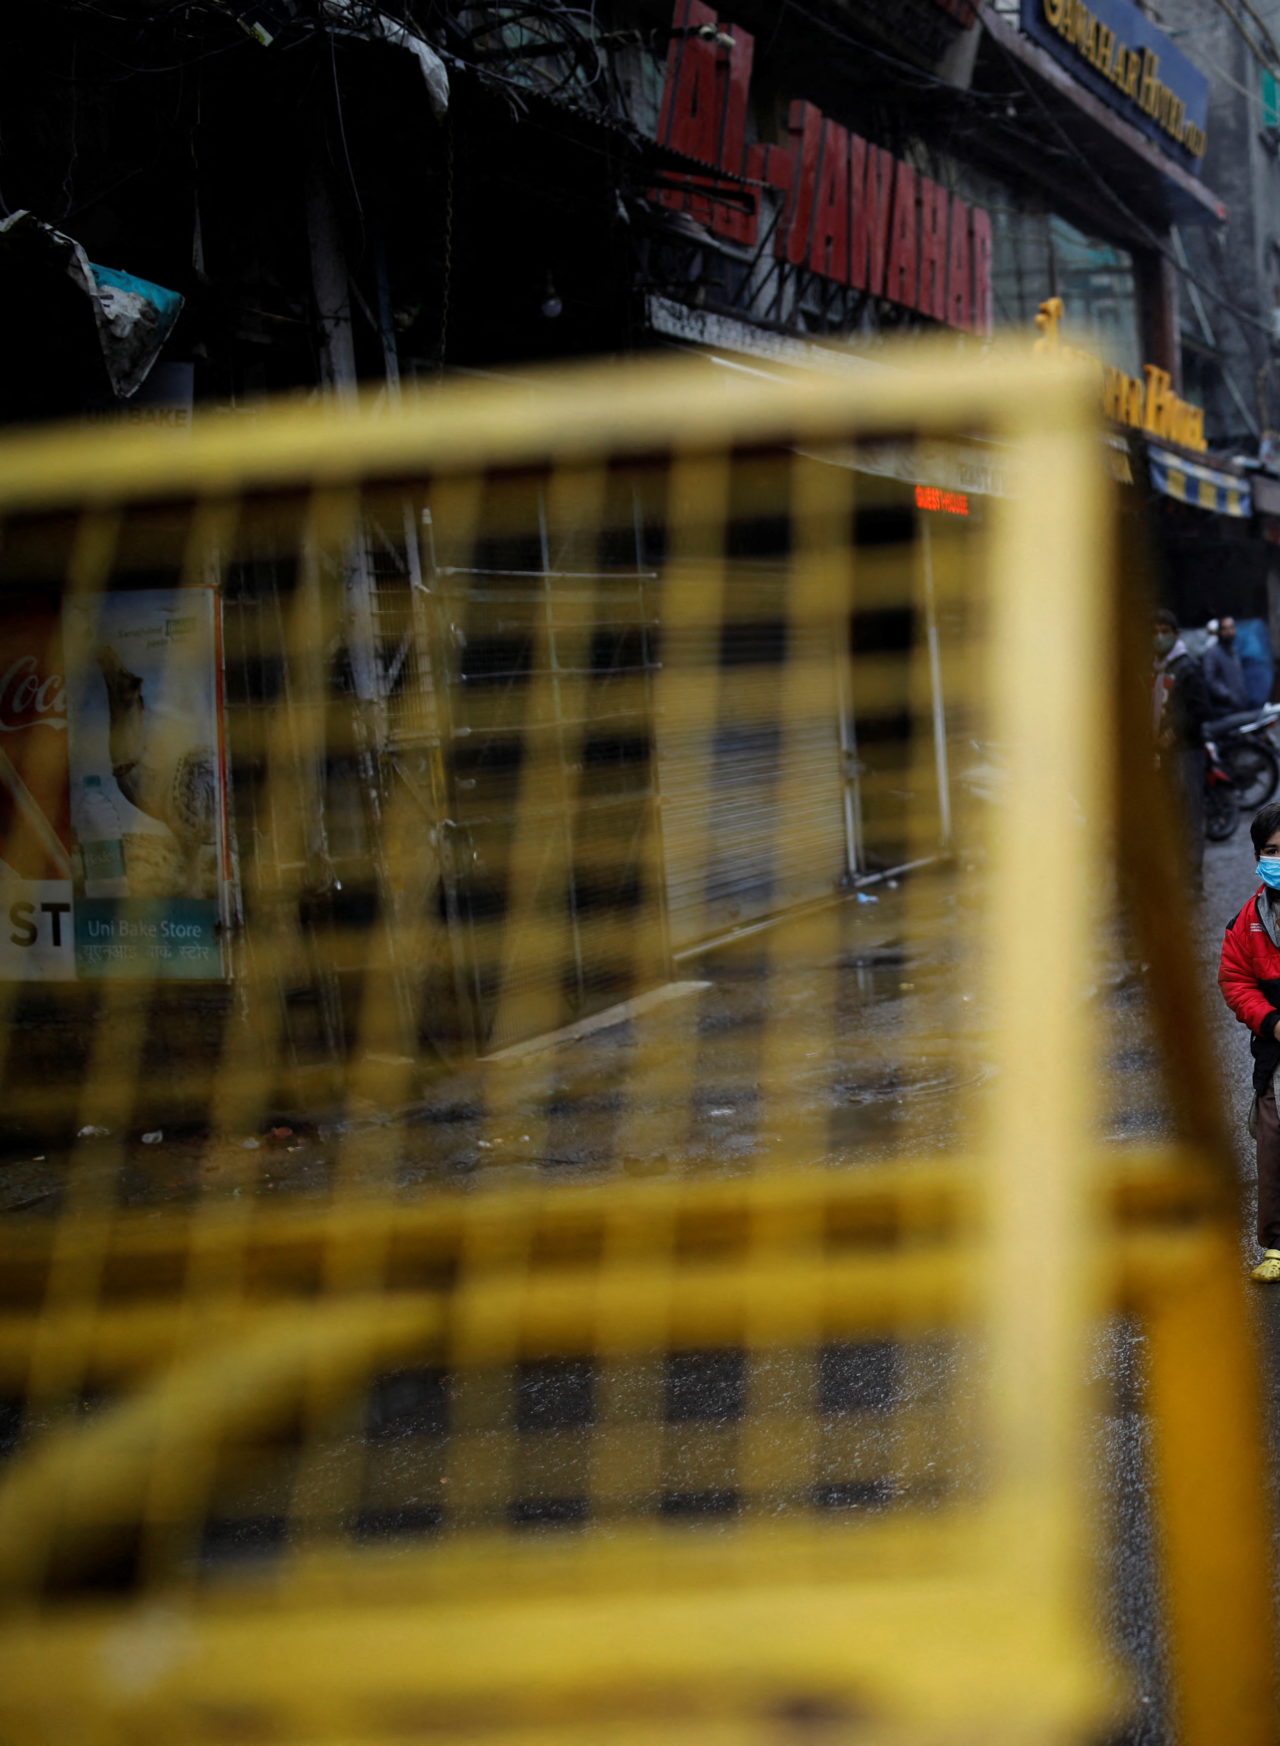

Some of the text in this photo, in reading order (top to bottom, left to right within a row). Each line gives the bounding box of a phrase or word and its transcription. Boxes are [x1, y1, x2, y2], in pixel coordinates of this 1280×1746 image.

[10, 903, 71, 947] ST
[88, 919, 202, 938] Uni Bake Store
